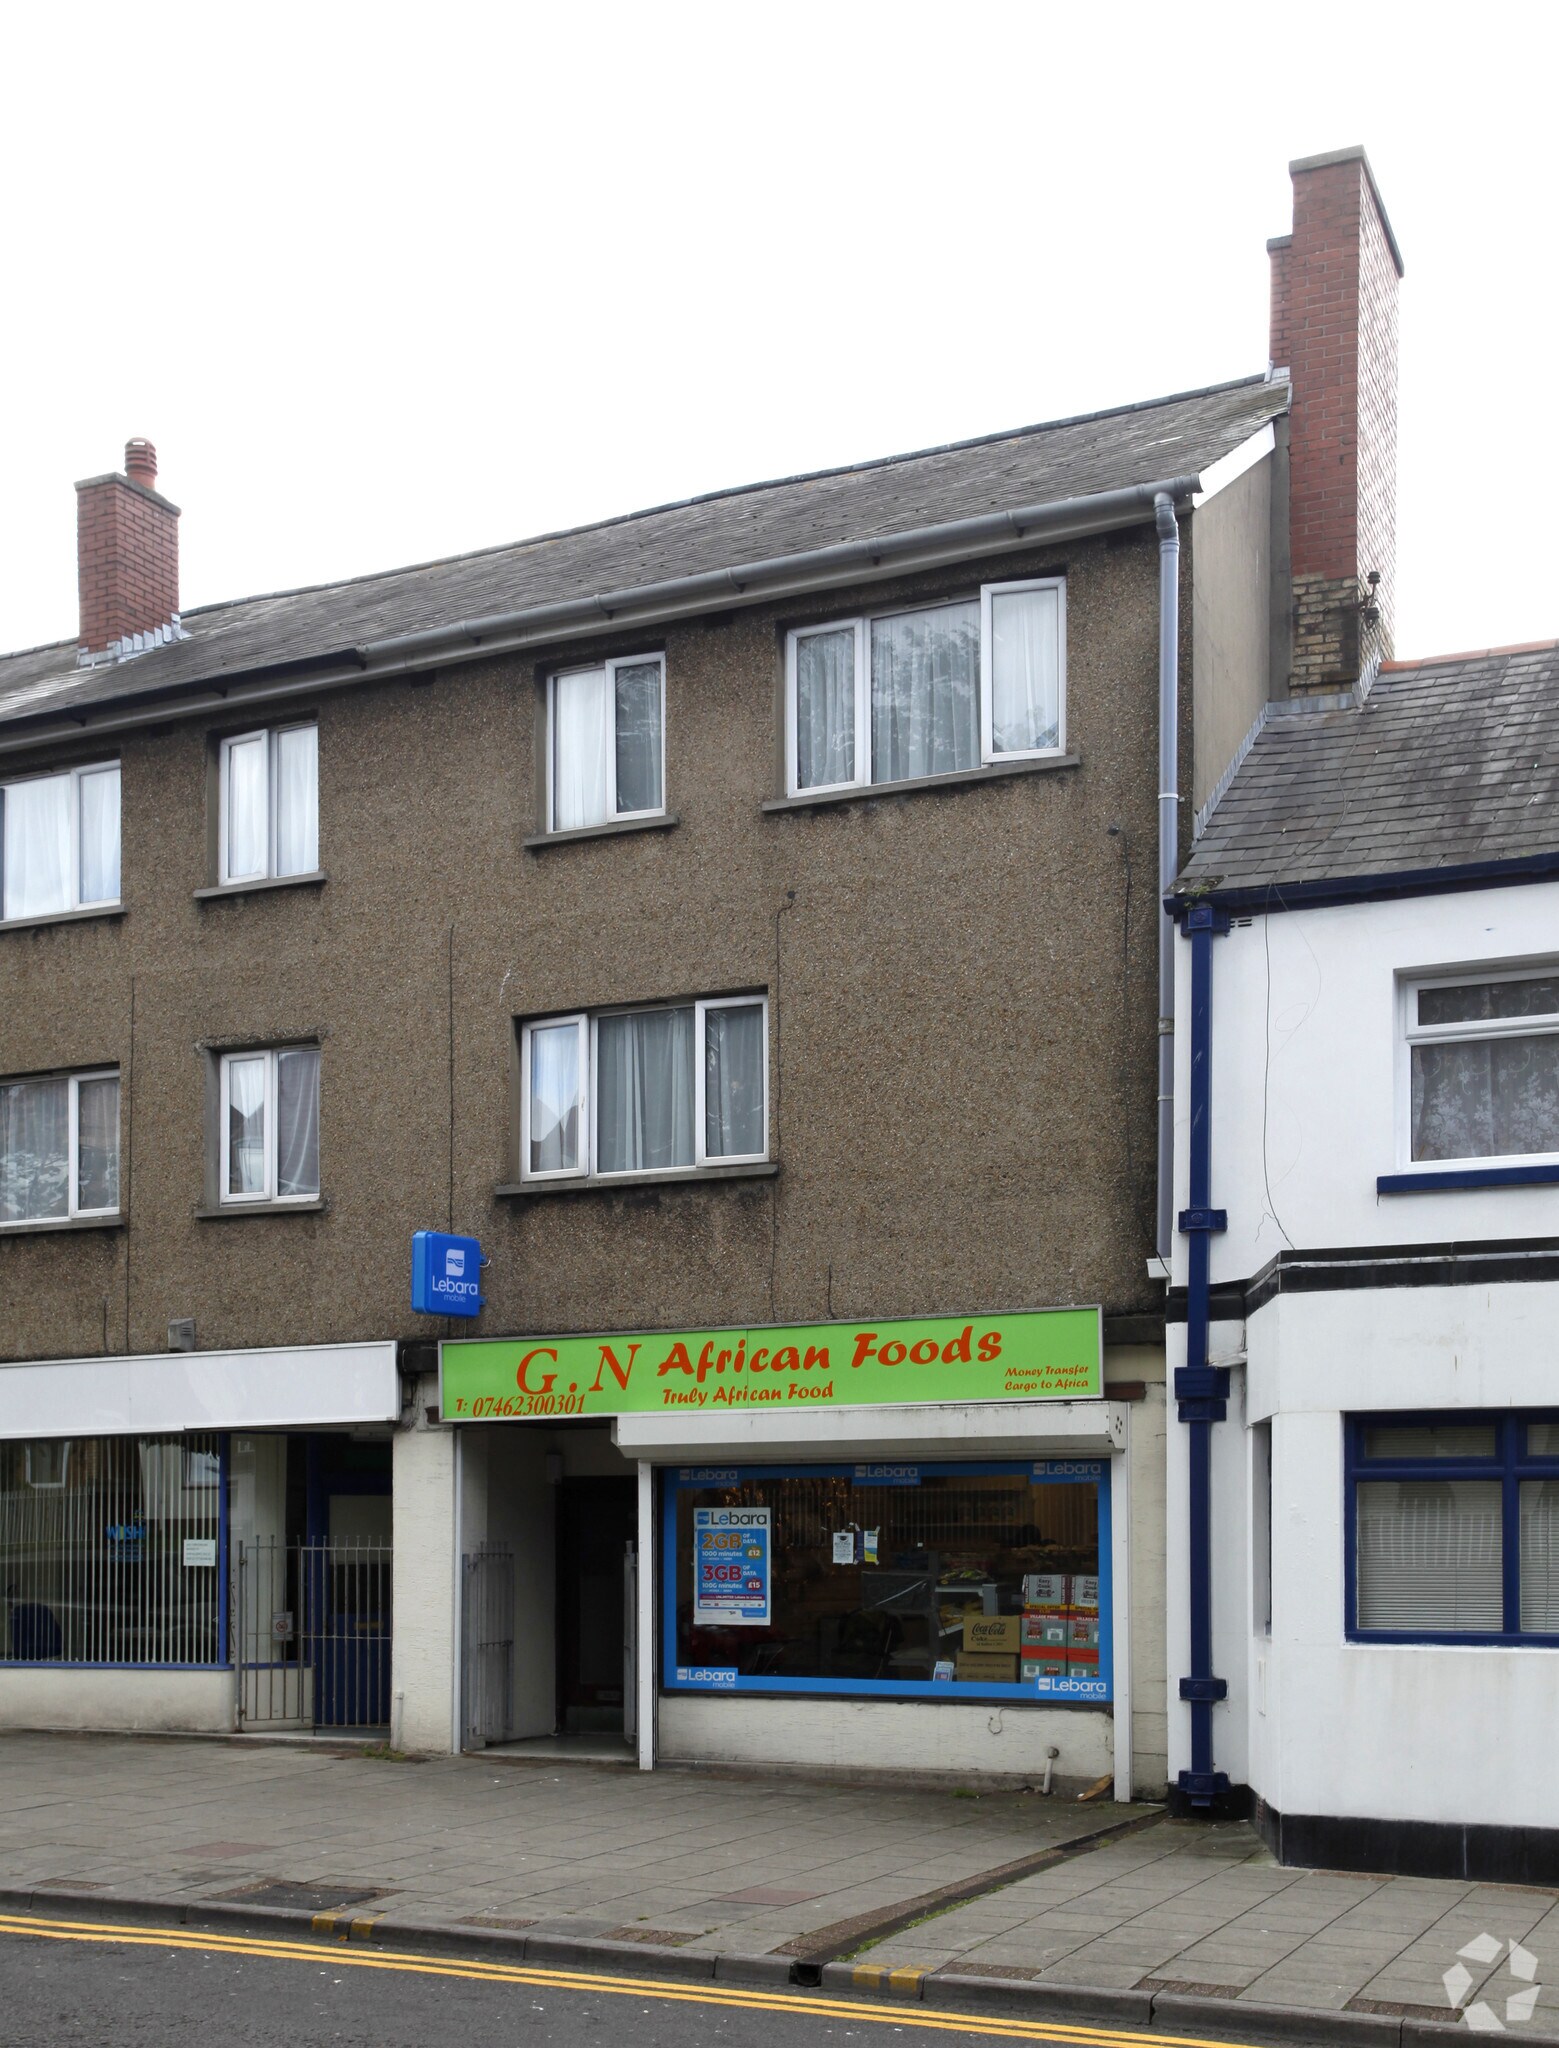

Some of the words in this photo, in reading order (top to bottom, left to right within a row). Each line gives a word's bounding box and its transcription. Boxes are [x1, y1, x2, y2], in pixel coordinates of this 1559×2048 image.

[432, 1275, 478, 1295] Lebara
[443, 1294, 467, 1303] mobile
[656, 1339, 830, 1383] African
[851, 1325, 1003, 1369] Foods
[1005, 1367, 1043, 1377] Money
[1046, 1364, 1089, 1376] Transfer
[1005, 1381, 1037, 1392] Cargo
[1041, 1380, 1052, 1389] to
[1055, 1378, 1089, 1390] Africa
[662, 1387, 709, 1407] Truly
[712, 1384, 782, 1406] African
[787, 1380, 834, 1400] Food
[456, 1398, 468, 1412] T:
[473, 1393, 586, 1418] 07462300301
[691, 1468, 738, 1480] Lebara
[867, 1463, 918, 1478] Lebara
[1046, 1461, 1101, 1475] Lebara
[711, 1511, 767, 1525] Lebara
[702, 1532, 743, 1550] 2GB
[748, 1549, 760, 1557] £12
[702, 1564, 743, 1582] 3GB
[748, 1581, 761, 1589] £15
[689, 1669, 735, 1681] Lebara
[1052, 1678, 1107, 1693] Lebara
